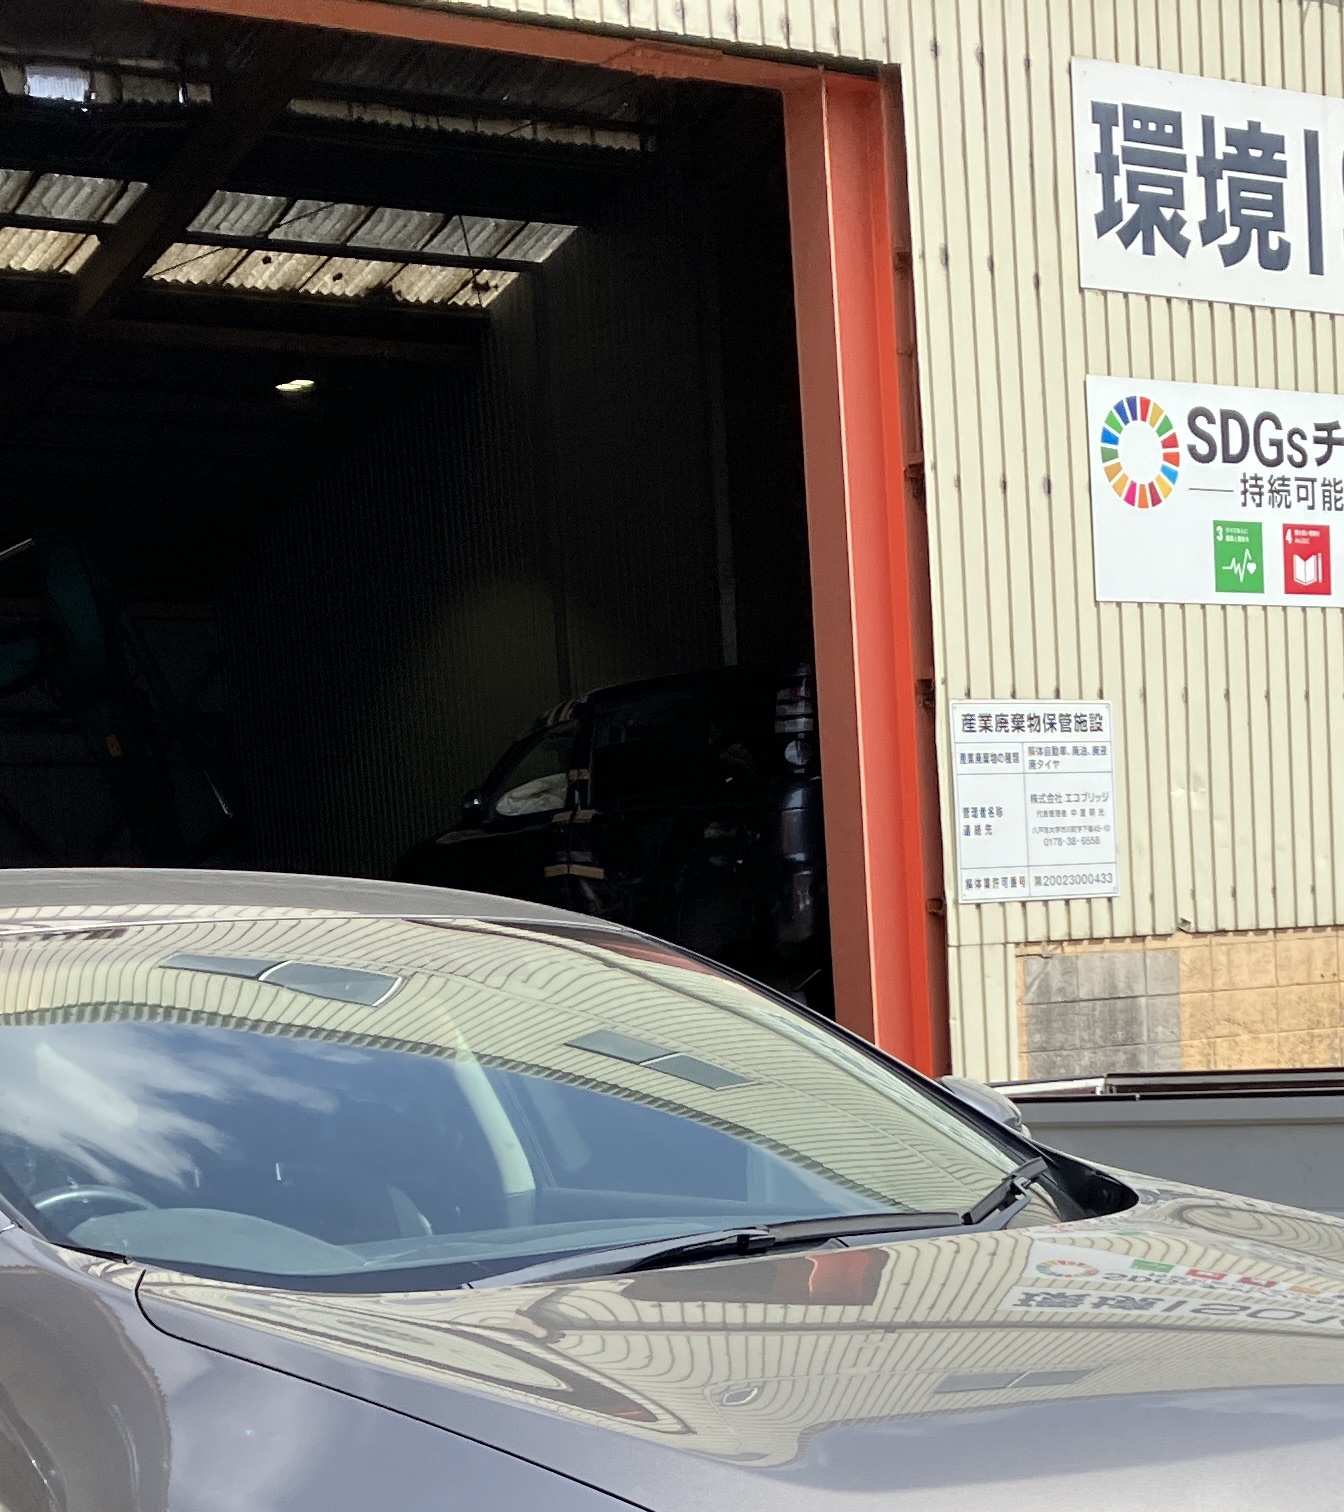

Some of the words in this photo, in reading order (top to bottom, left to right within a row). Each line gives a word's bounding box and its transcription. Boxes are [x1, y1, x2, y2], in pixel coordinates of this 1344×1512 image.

[1216, 525, 1224, 542] 3
[1285, 528, 1293, 545] 4
[961, 712, 1104, 734] 産業廃棄物保管施設
[1030, 793, 1063, 805] 株式会社
